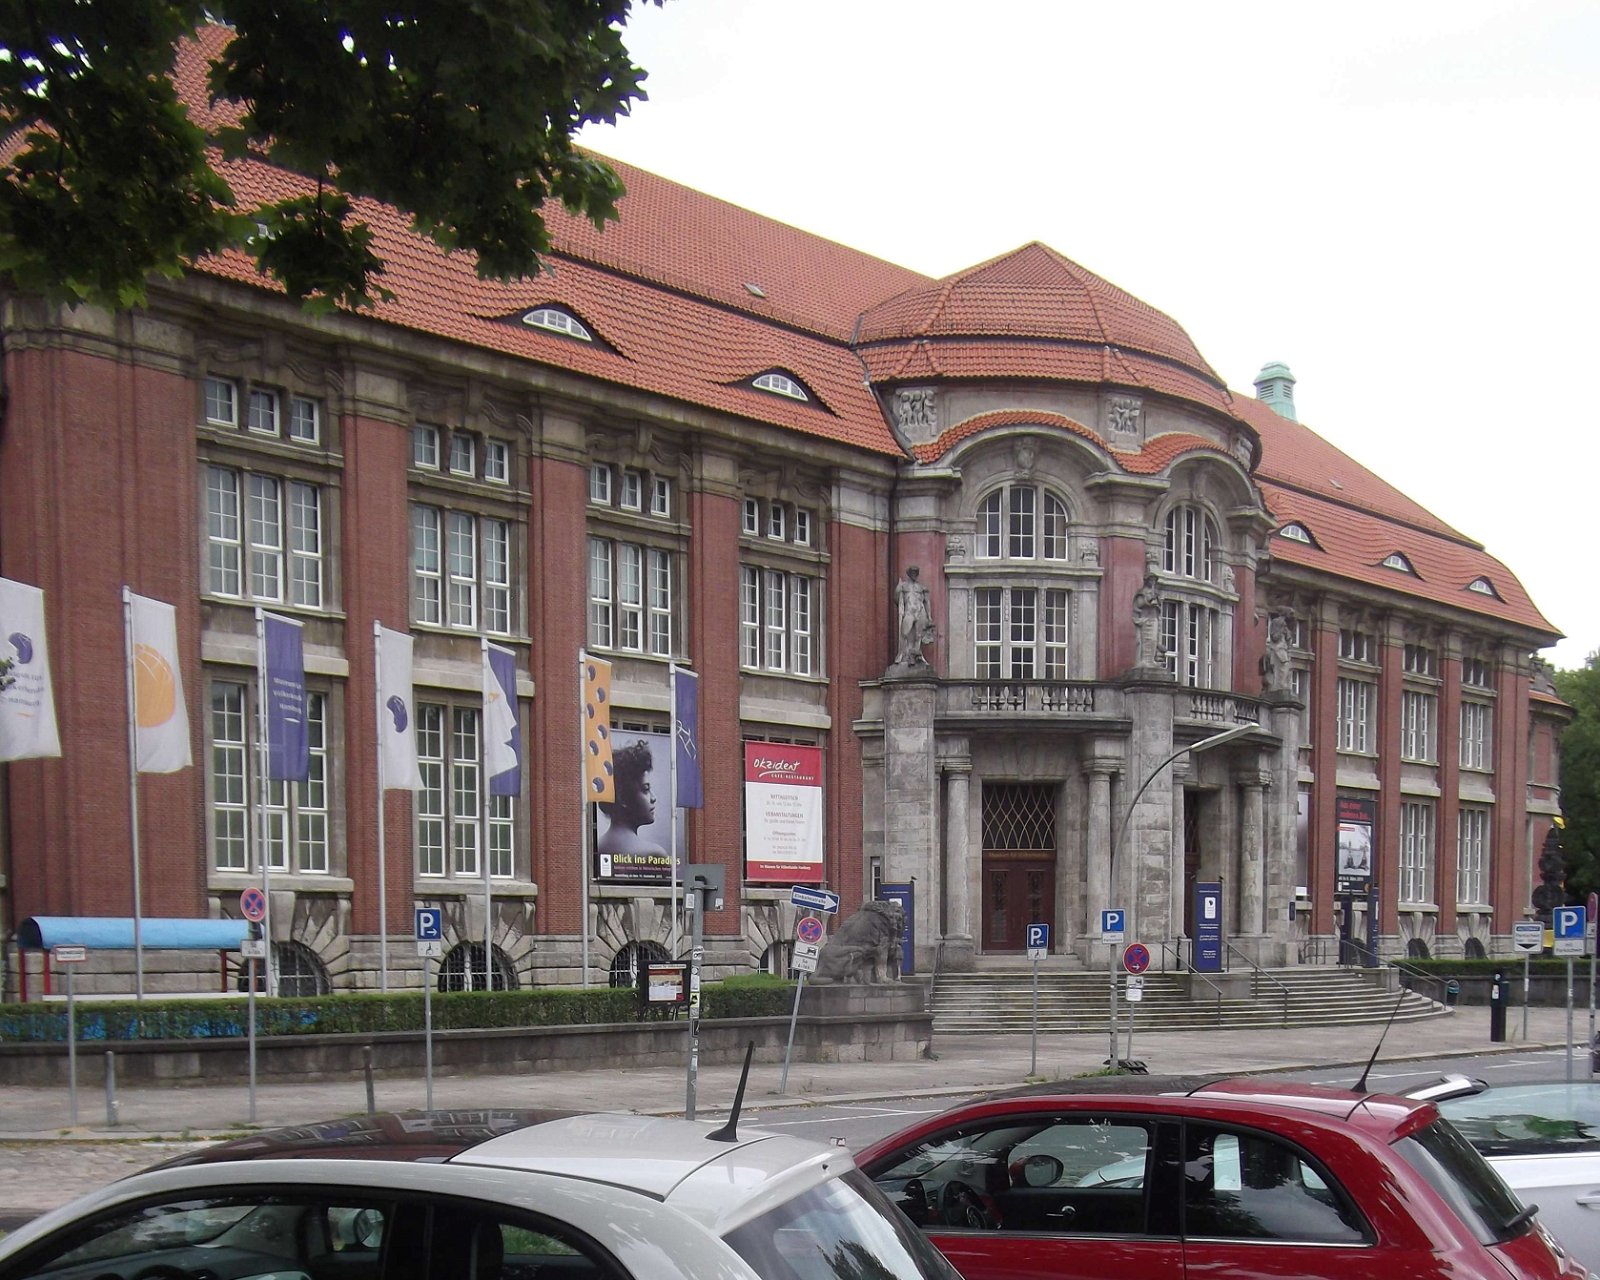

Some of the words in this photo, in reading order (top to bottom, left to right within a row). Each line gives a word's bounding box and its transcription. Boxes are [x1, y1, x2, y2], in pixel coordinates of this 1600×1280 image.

[613, 853, 632, 864] Blick
[648, 855, 681, 865] Paradis
[420, 912, 434, 937] P
[1106, 912, 1119, 930] P
[1561, 911, 1578, 936] P
[1030, 927, 1042, 946] P
